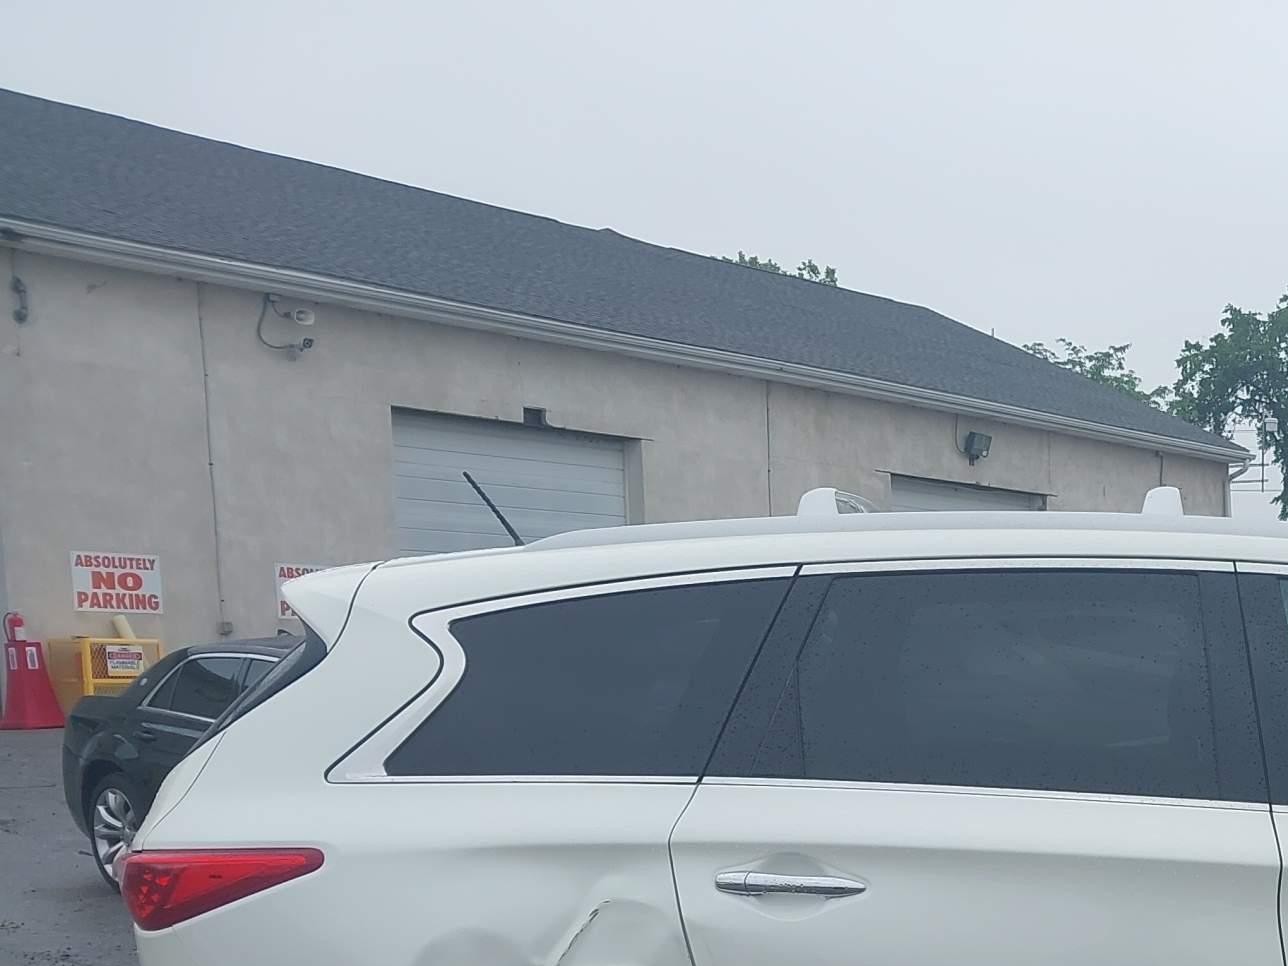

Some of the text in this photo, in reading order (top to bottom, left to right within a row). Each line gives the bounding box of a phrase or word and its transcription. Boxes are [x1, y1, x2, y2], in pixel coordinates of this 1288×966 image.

[75, 554, 155, 571] ABSOLUTELY
[91, 571, 143, 591] NO
[279, 566, 321, 578] ABSO
[77, 591, 160, 611] PARKING
